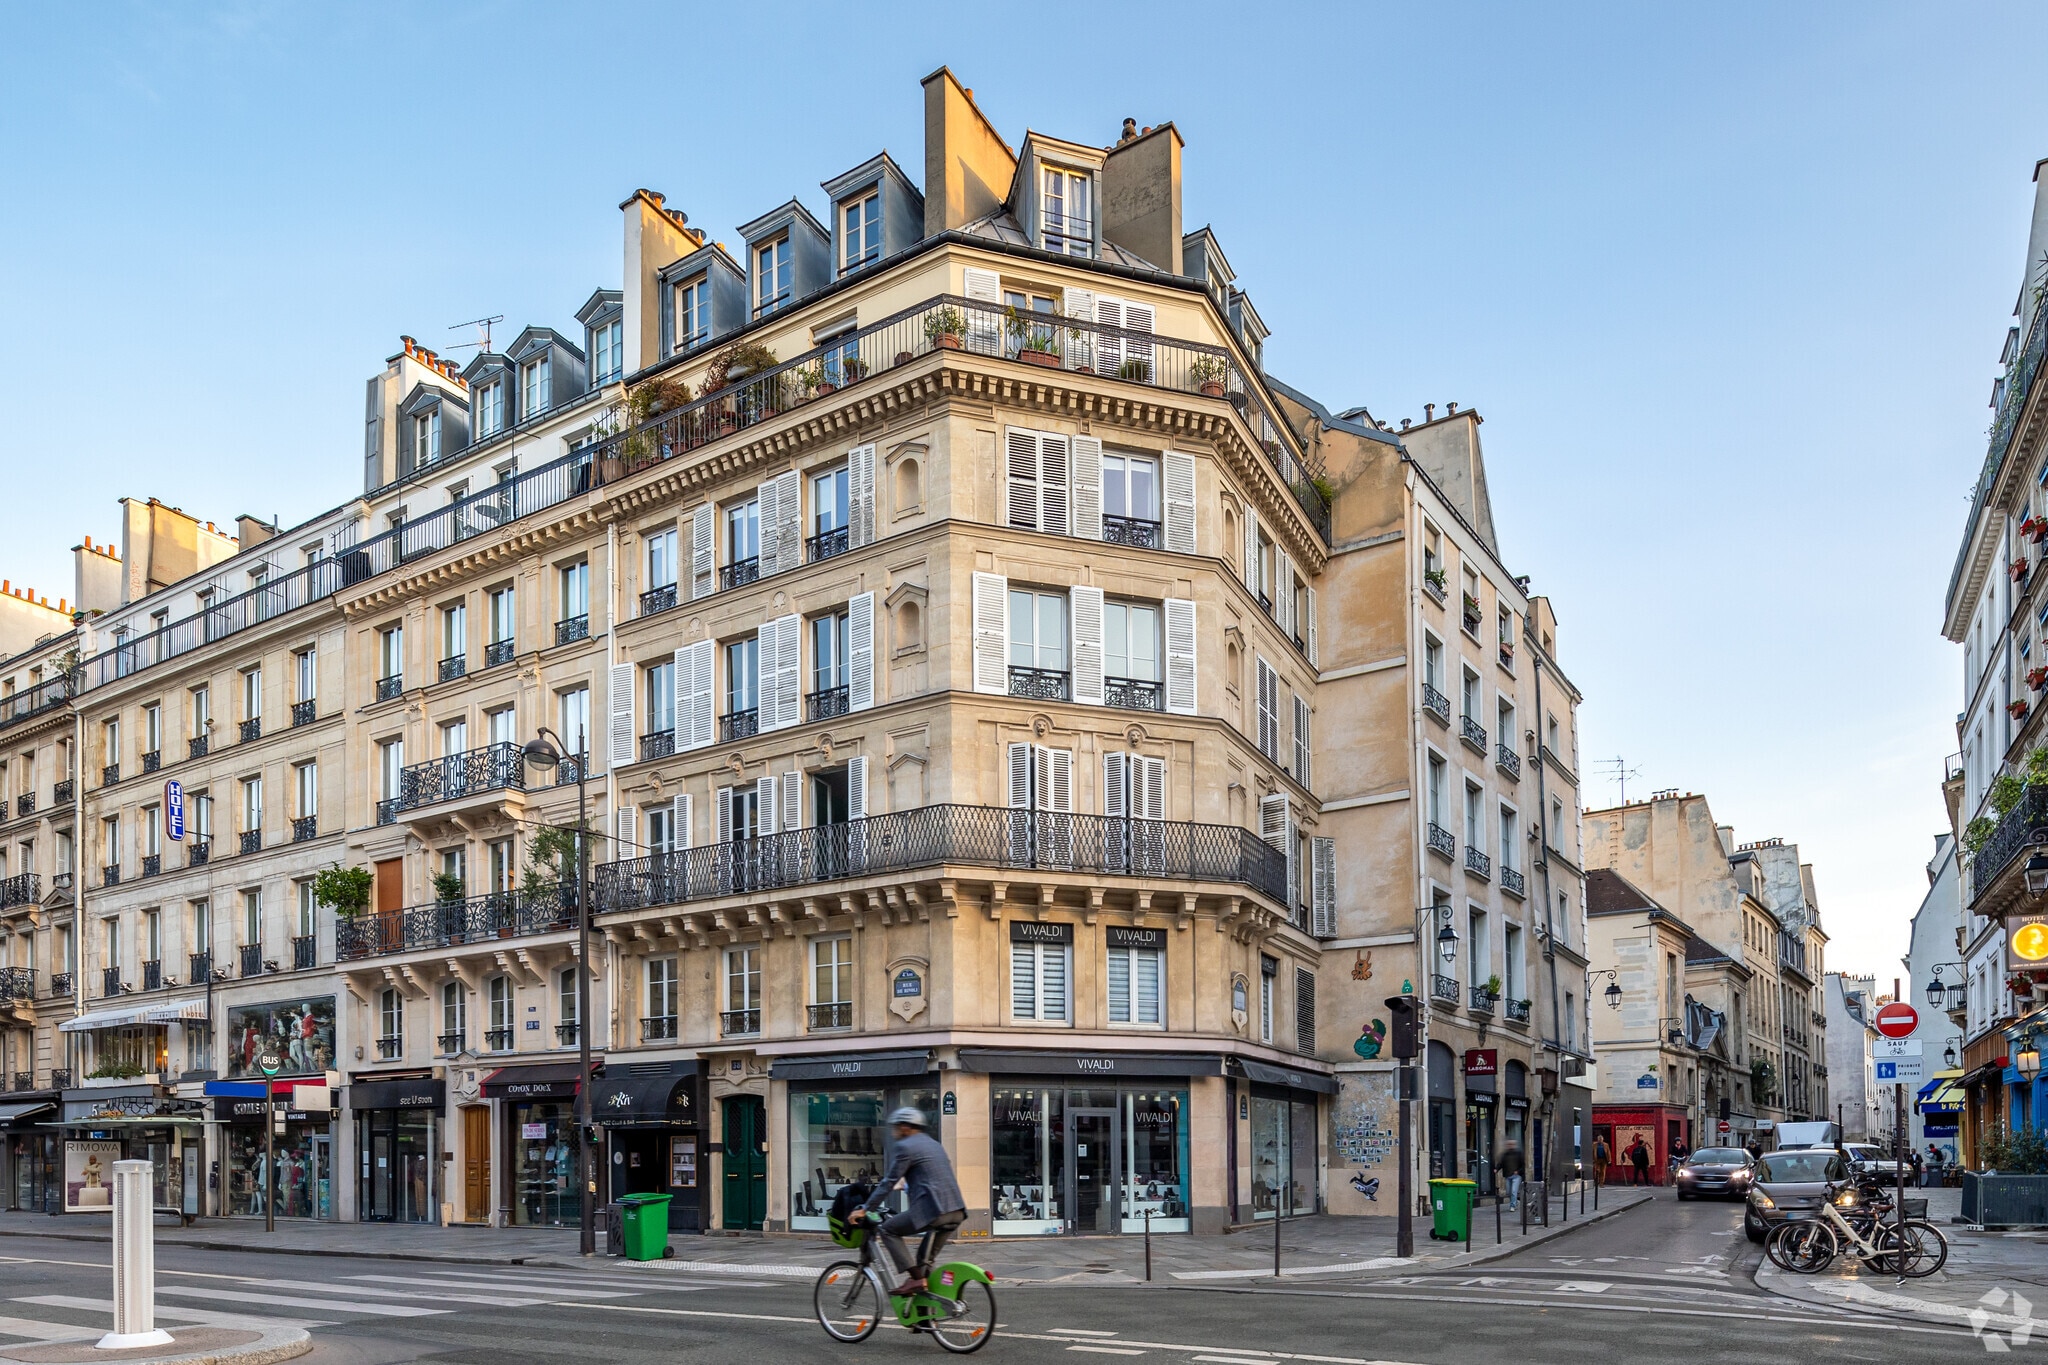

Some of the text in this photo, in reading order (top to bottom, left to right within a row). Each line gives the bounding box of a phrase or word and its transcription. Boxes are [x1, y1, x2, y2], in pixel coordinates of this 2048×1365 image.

[170, 784, 182, 837] HOTEL
[1020, 923, 1063, 937] VIVALDI
[1115, 929, 1156, 942] VIVALDI
[262, 1055, 279, 1065] BUS
[1077, 1059, 1114, 1070] VIVALDI
[832, 1062, 861, 1073] VIVALDI
[411, 1096, 417, 1104] U
[1008, 1110, 1043, 1122] VIVALD
[1135, 1112, 1173, 1123] VIVALDI
[66, 1142, 119, 1152] RIMOWA
